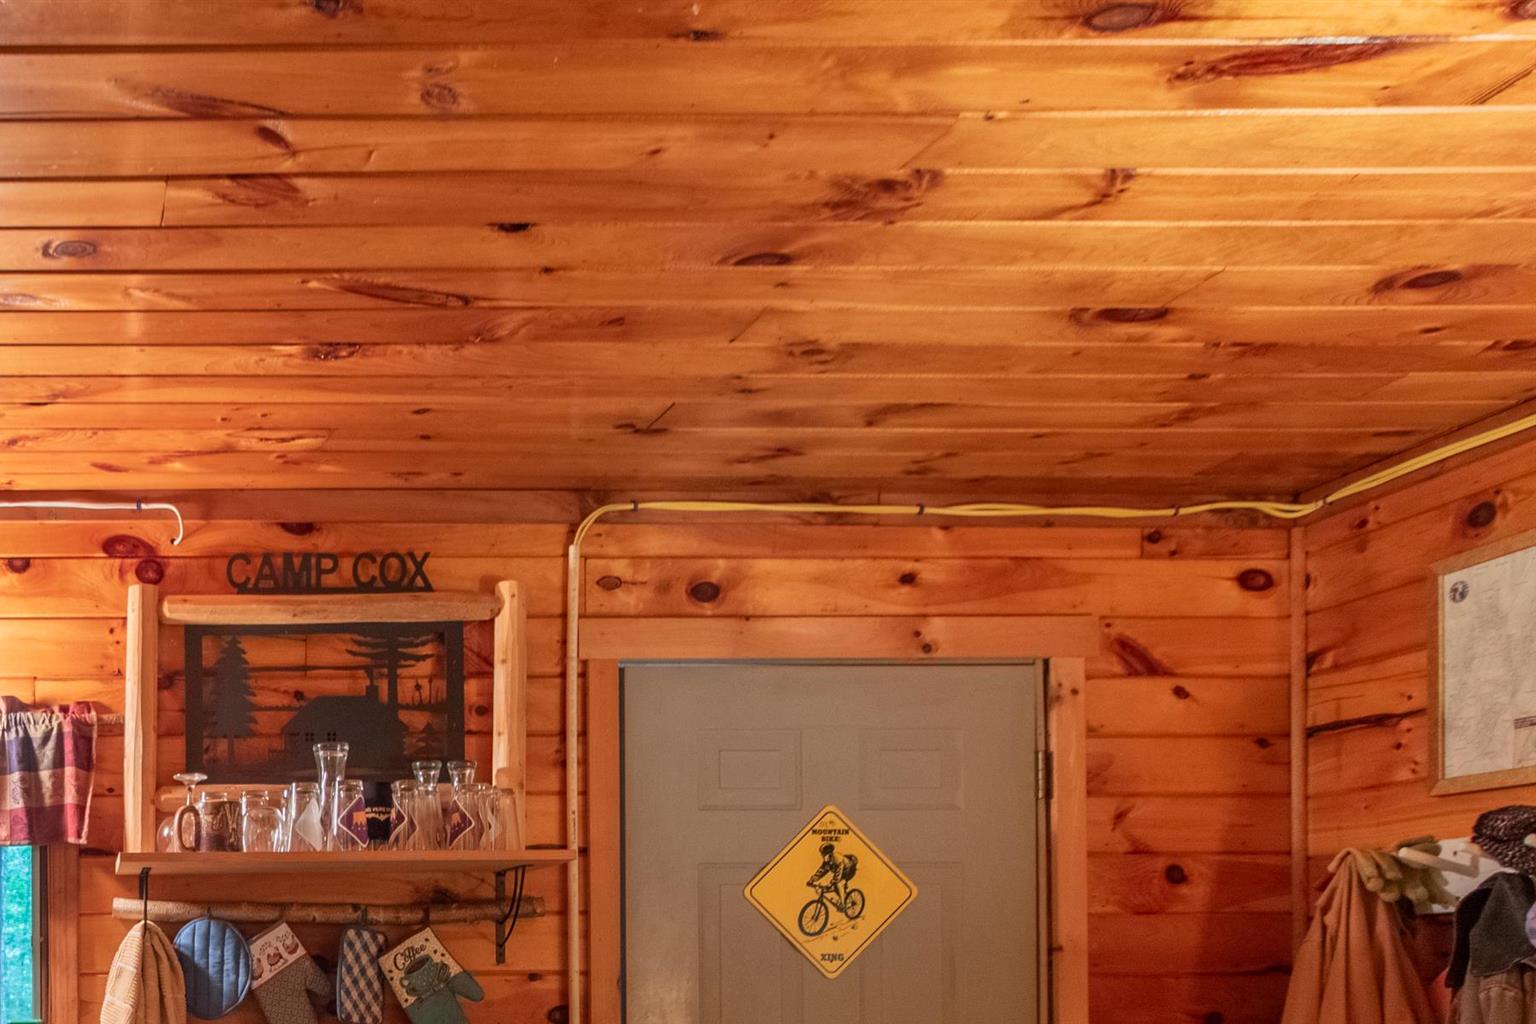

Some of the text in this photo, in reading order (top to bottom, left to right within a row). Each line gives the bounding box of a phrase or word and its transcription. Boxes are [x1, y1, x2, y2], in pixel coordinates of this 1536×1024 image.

[226, 552, 433, 591] CAMP COX
[811, 828, 850, 836] MOUNTAIN
[393, 943, 426, 971] Coffee
[820, 953, 845, 962] XING
